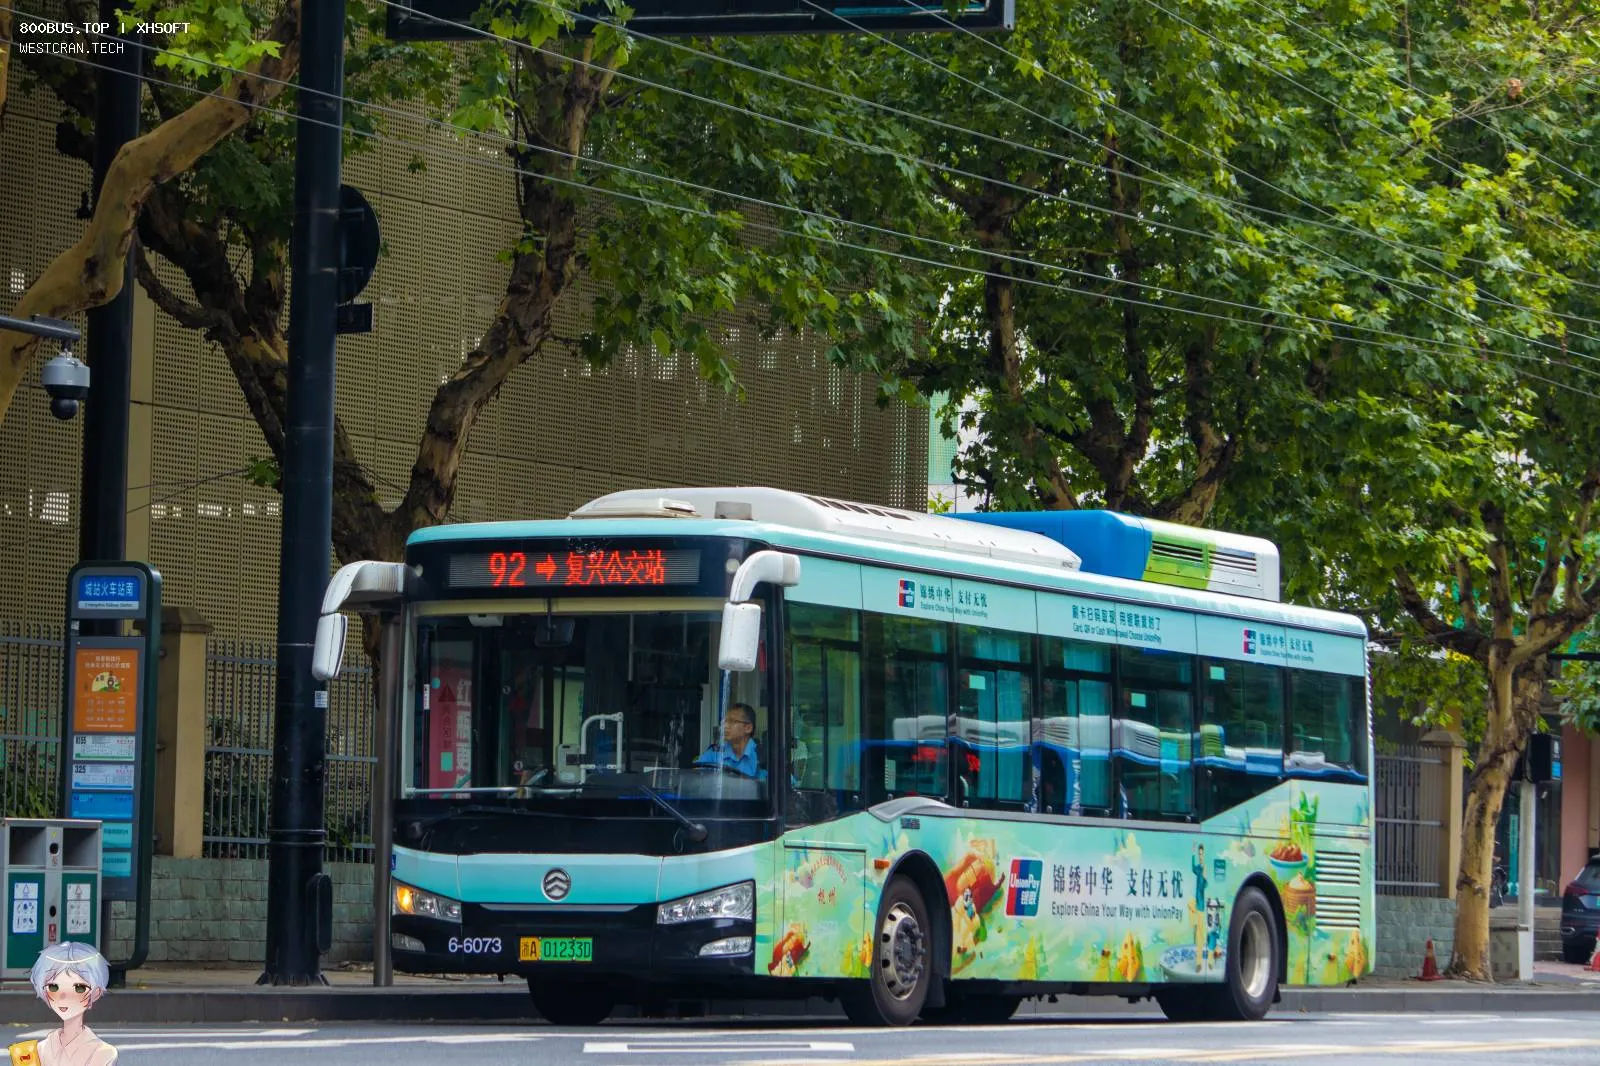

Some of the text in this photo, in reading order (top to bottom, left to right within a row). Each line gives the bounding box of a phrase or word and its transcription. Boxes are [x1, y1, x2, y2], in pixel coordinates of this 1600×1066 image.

[488, 550, 667, 587] 92 复兴公交站
[84, 581, 135, 597] 城站火车站南
[1010, 873, 1040, 892] UnionPay
[1053, 864, 1184, 898] 锦绣中华 支付无忧
[1051, 901, 1183, 921] Explore China Your Way with UnionPay
[448, 937, 502, 953] 6-6073
